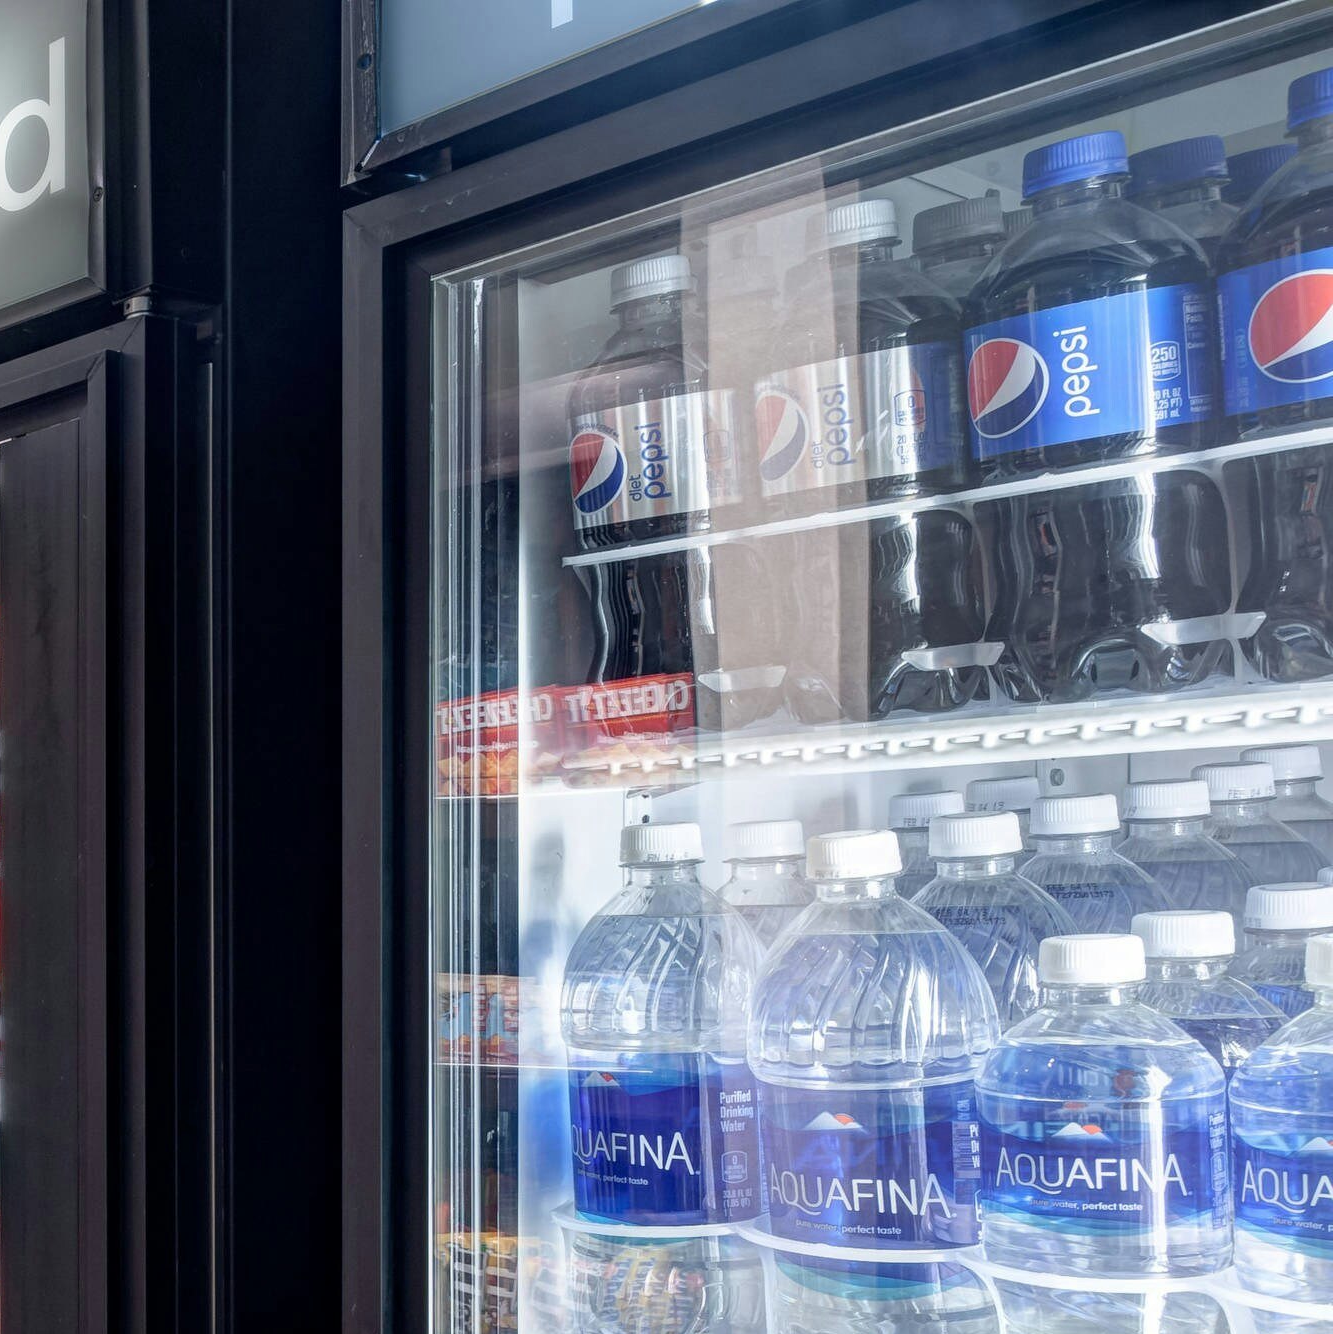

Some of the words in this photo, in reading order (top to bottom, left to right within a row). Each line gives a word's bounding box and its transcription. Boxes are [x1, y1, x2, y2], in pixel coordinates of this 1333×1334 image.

[1152, 346, 1176, 361] 250
[1053, 325, 1100, 418] pepsi
[817, 383, 857, 466] pepsi
[634, 421, 672, 500] pepsi
[812, 441, 822, 469] diet
[629, 474, 641, 502] diet
[719, 1090, 752, 1104] Purified
[720, 1105, 754, 1119] Drinking
[720, 1120, 746, 1133] Water
[996, 1147, 1188, 1196] AQUAFINA
[629, 1177, 649, 1186] taste
[770, 1162, 952, 1218] AQUAFINA
[1051, 1200, 1080, 1210] water,
[1081, 1201, 1117, 1212] perfect
[1118, 1202, 1143, 1212] taste
[841, 1224, 875, 1235] perfect
[877, 1225, 902, 1235] taste
[1293, 1219, 1325, 1231] water,
